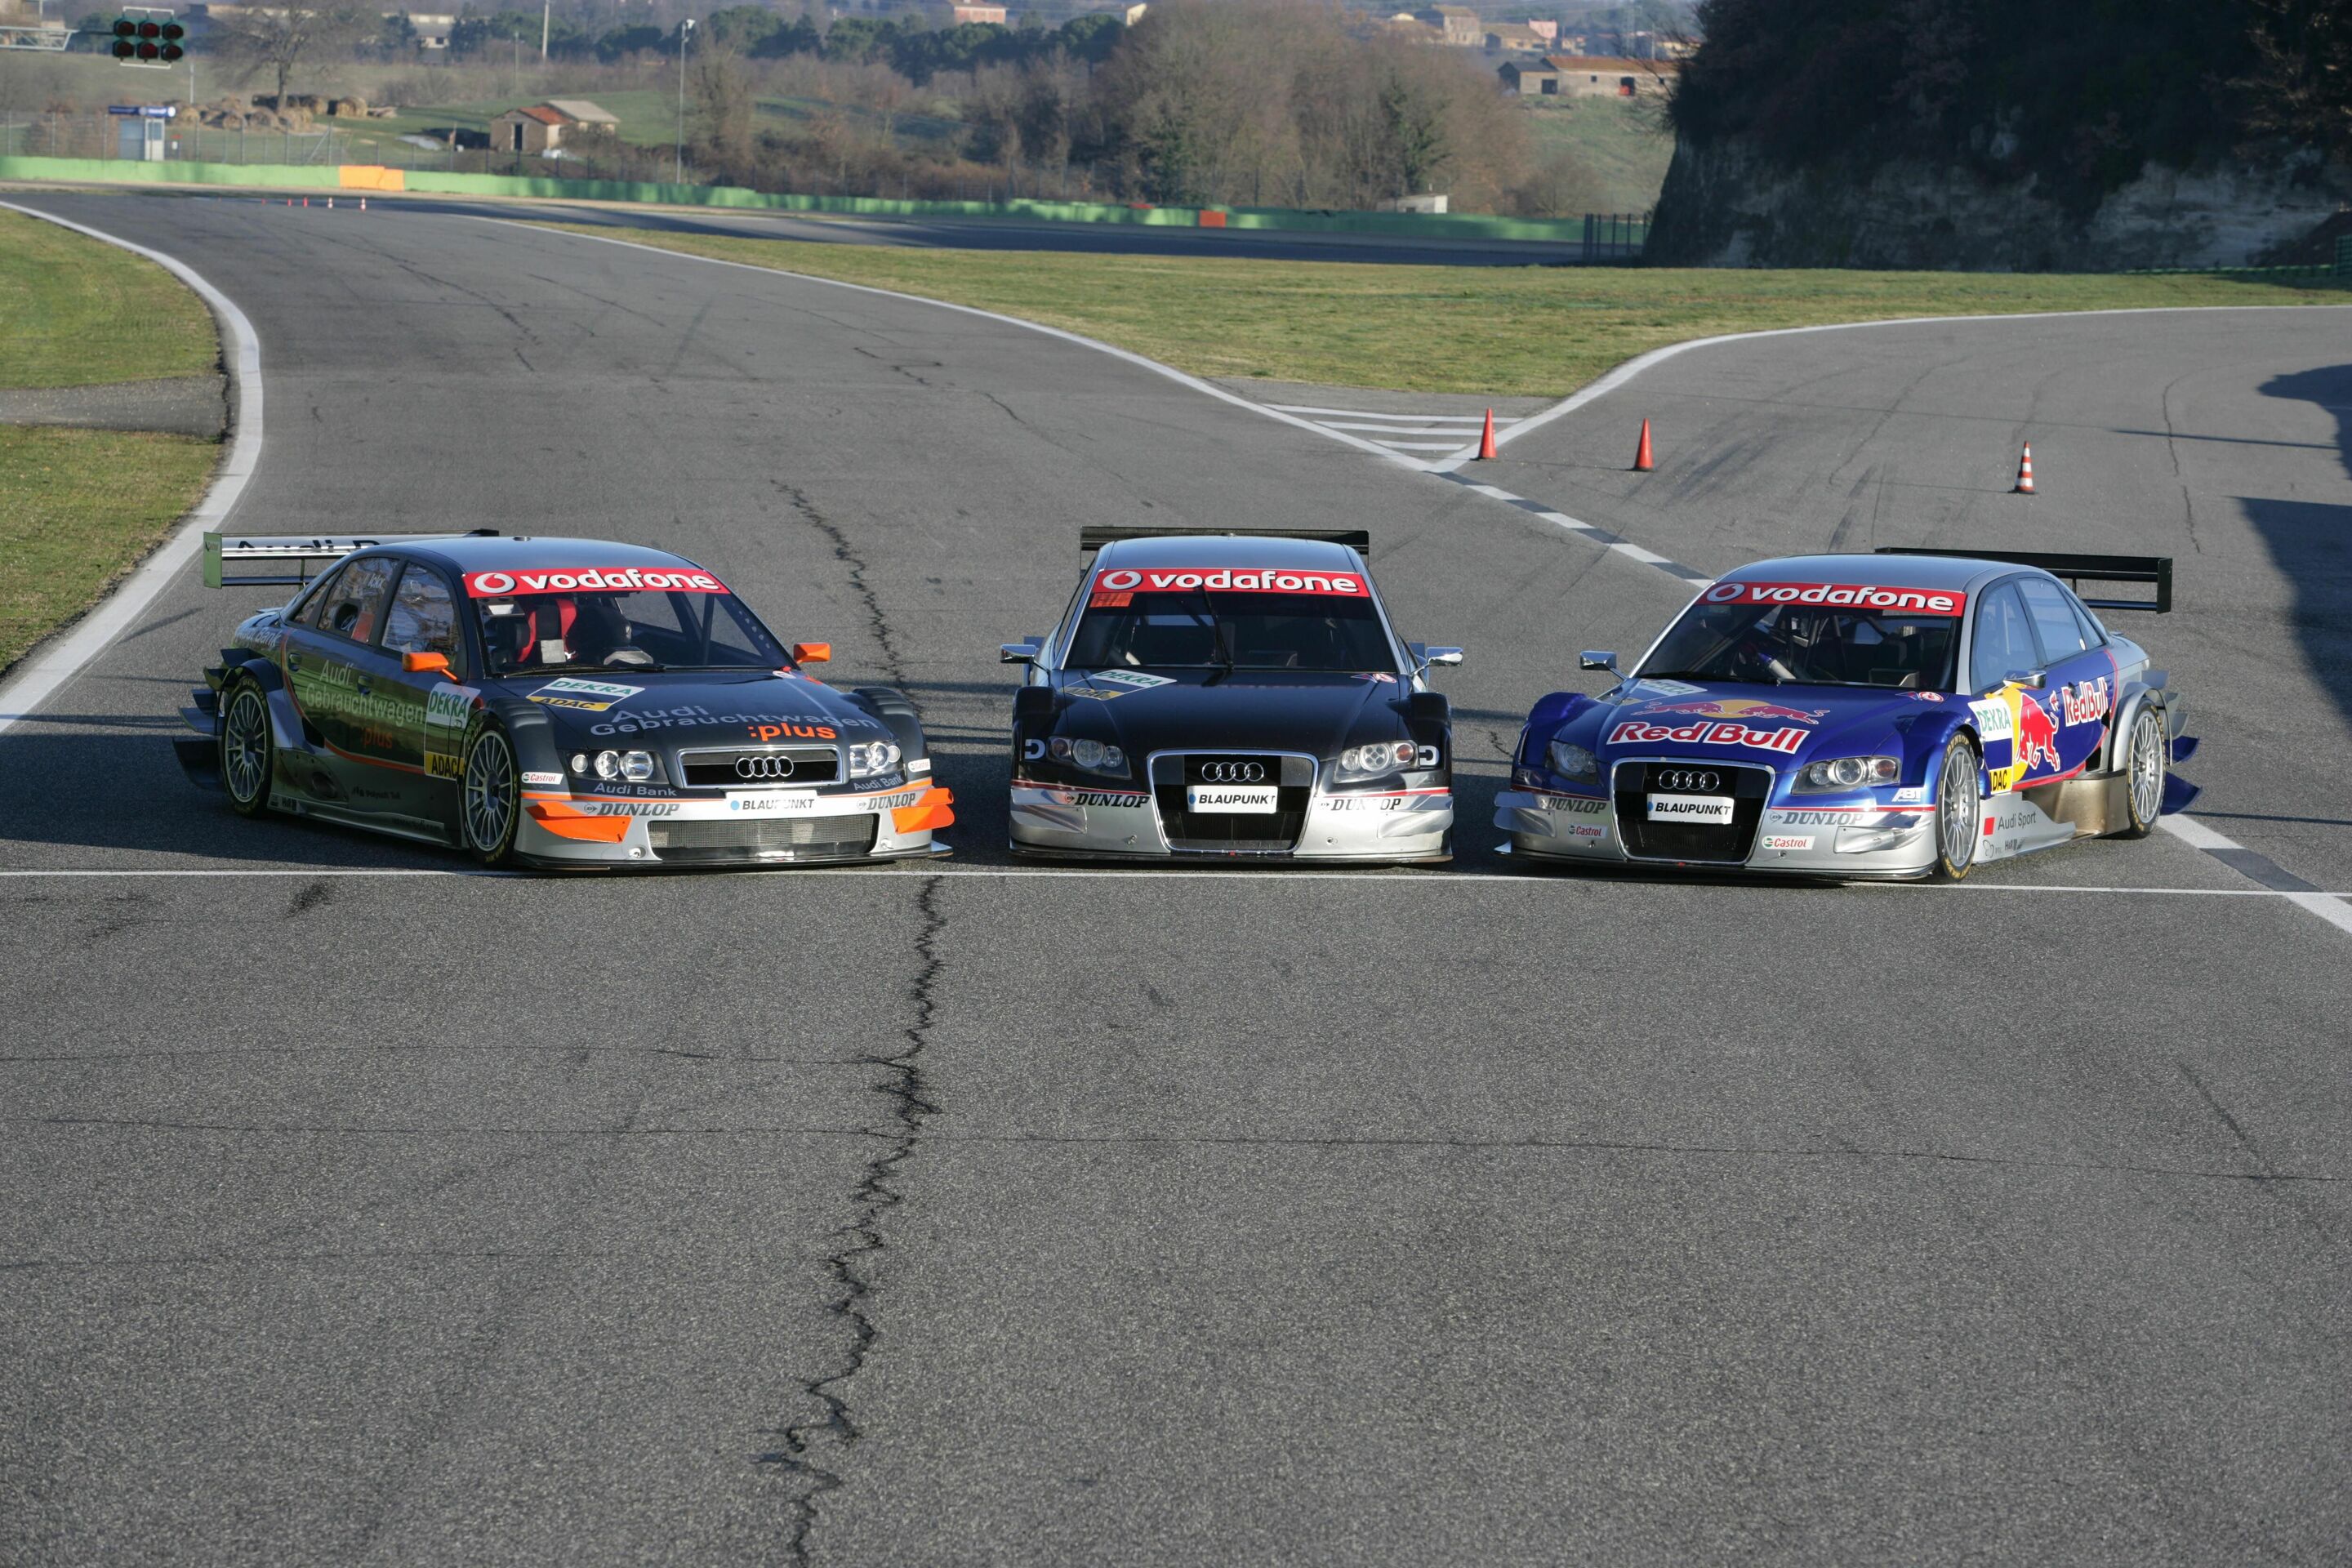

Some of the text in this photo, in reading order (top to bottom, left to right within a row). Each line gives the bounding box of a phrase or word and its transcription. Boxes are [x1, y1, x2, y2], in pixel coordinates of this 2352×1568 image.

[520, 568, 719, 590] vodafone
[1151, 570, 1359, 592] vodafone
[1752, 585, 1954, 612] vodafone
[319, 659, 354, 684] Audi
[1095, 670, 1162, 686] DEKRA
[550, 680, 632, 696] DEKRA
[305, 683, 424, 727] Gebrauchtwagen
[429, 690, 470, 719] DEKRA
[536, 697, 595, 709] ADAC
[2062, 681, 2087, 727] Red
[612, 706, 710, 724] Audi
[1976, 706, 2011, 733] DEKRA
[590, 713, 879, 736] Gebrauchtwagen
[747, 723, 837, 742] :plus
[1609, 721, 1808, 753] Red Bull
[432, 755, 460, 776] ADAC
[530, 773, 556, 782] Castrol
[853, 773, 904, 791] Audi Bank
[594, 782, 677, 797] Audi Bank
[1891, 787, 1922, 801] ABT
[866, 792, 916, 811] DUNLOP
[1074, 793, 1150, 808] DUNLOP
[1198, 794, 1276, 804] BLAUPUNKT
[1330, 798, 1401, 811] DUNOP
[1547, 796, 1607, 815] DUNLOP
[596, 803, 681, 817] DUNLOP
[1655, 802, 1731, 815] BLAUPUNKT
[1782, 811, 1864, 826] DUNLOP
[1998, 811, 2037, 831] Audi Sport
[1575, 826, 1602, 837] Castrol
[1774, 838, 1808, 849] Castrol
